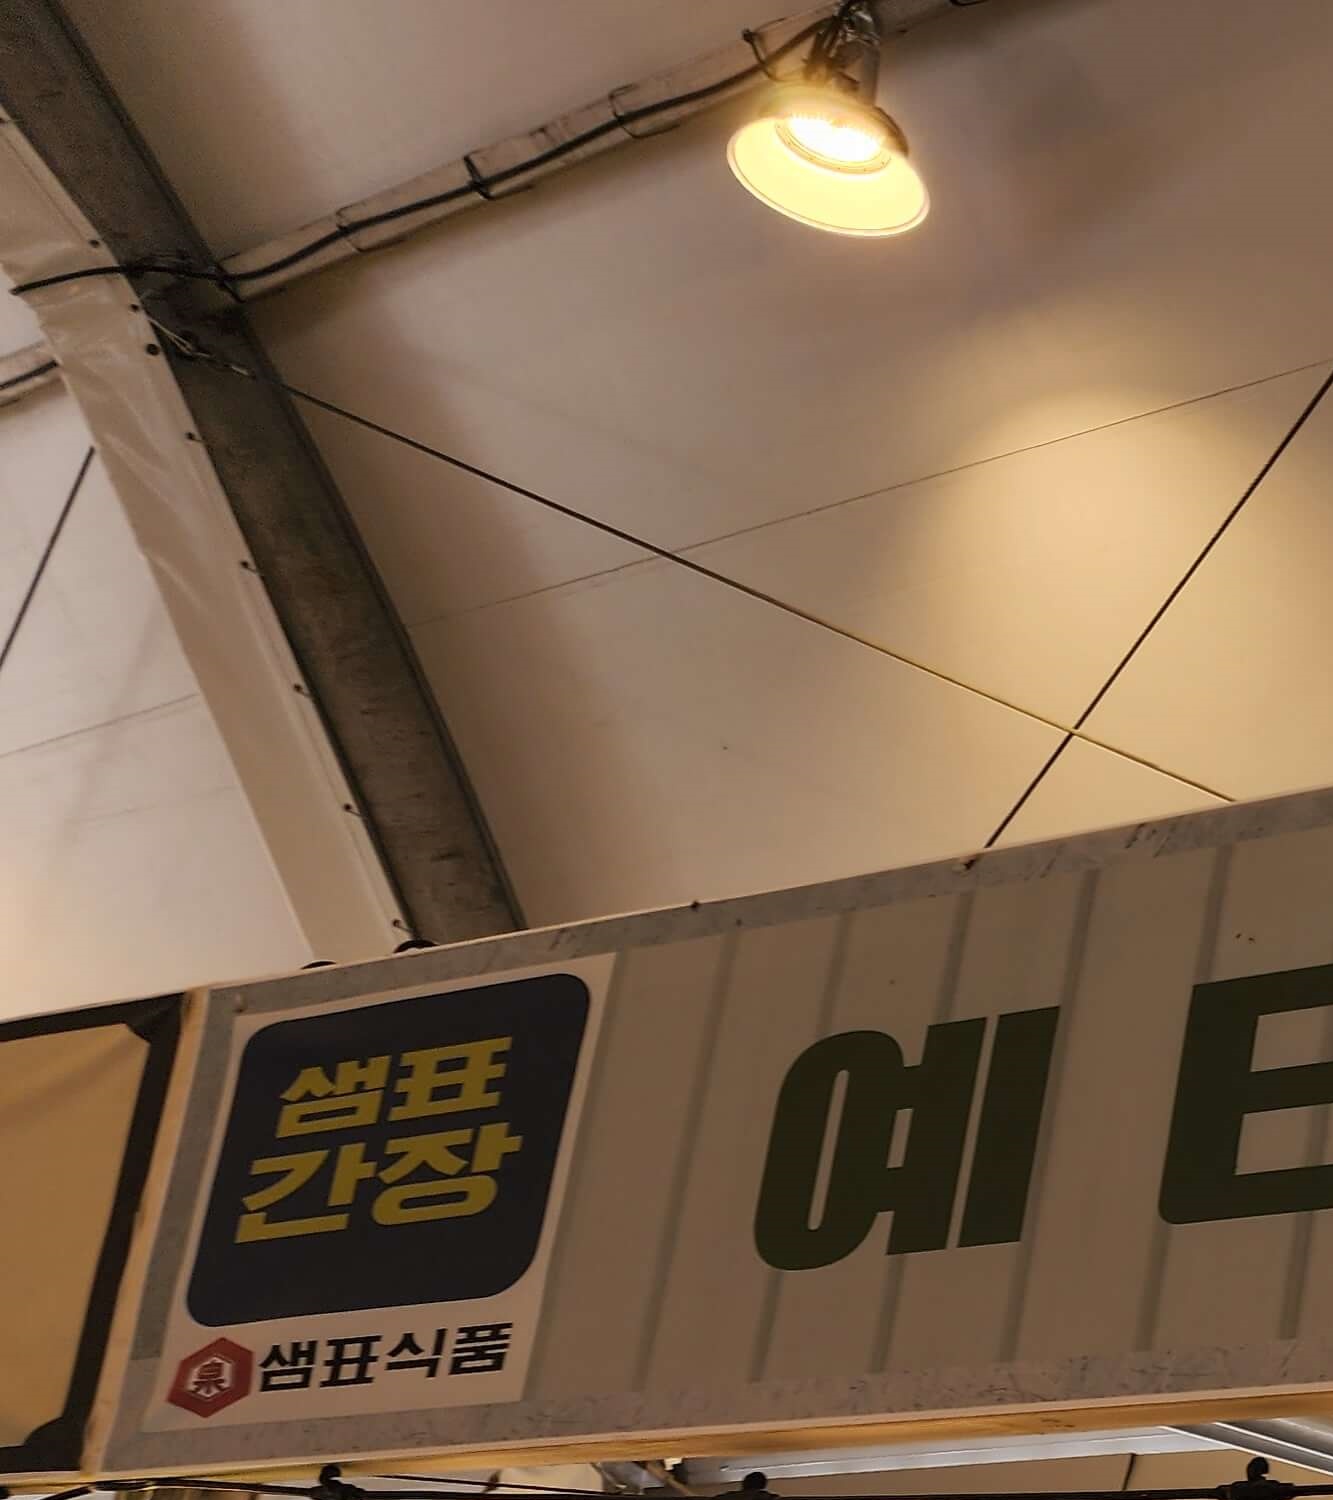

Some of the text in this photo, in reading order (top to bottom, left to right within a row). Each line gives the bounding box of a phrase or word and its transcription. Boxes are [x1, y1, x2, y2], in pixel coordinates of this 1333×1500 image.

[275, 1036, 513, 1139] 샘표
[234, 1122, 524, 1244] 간장
[258, 1322, 513, 1392] 샘표식품
